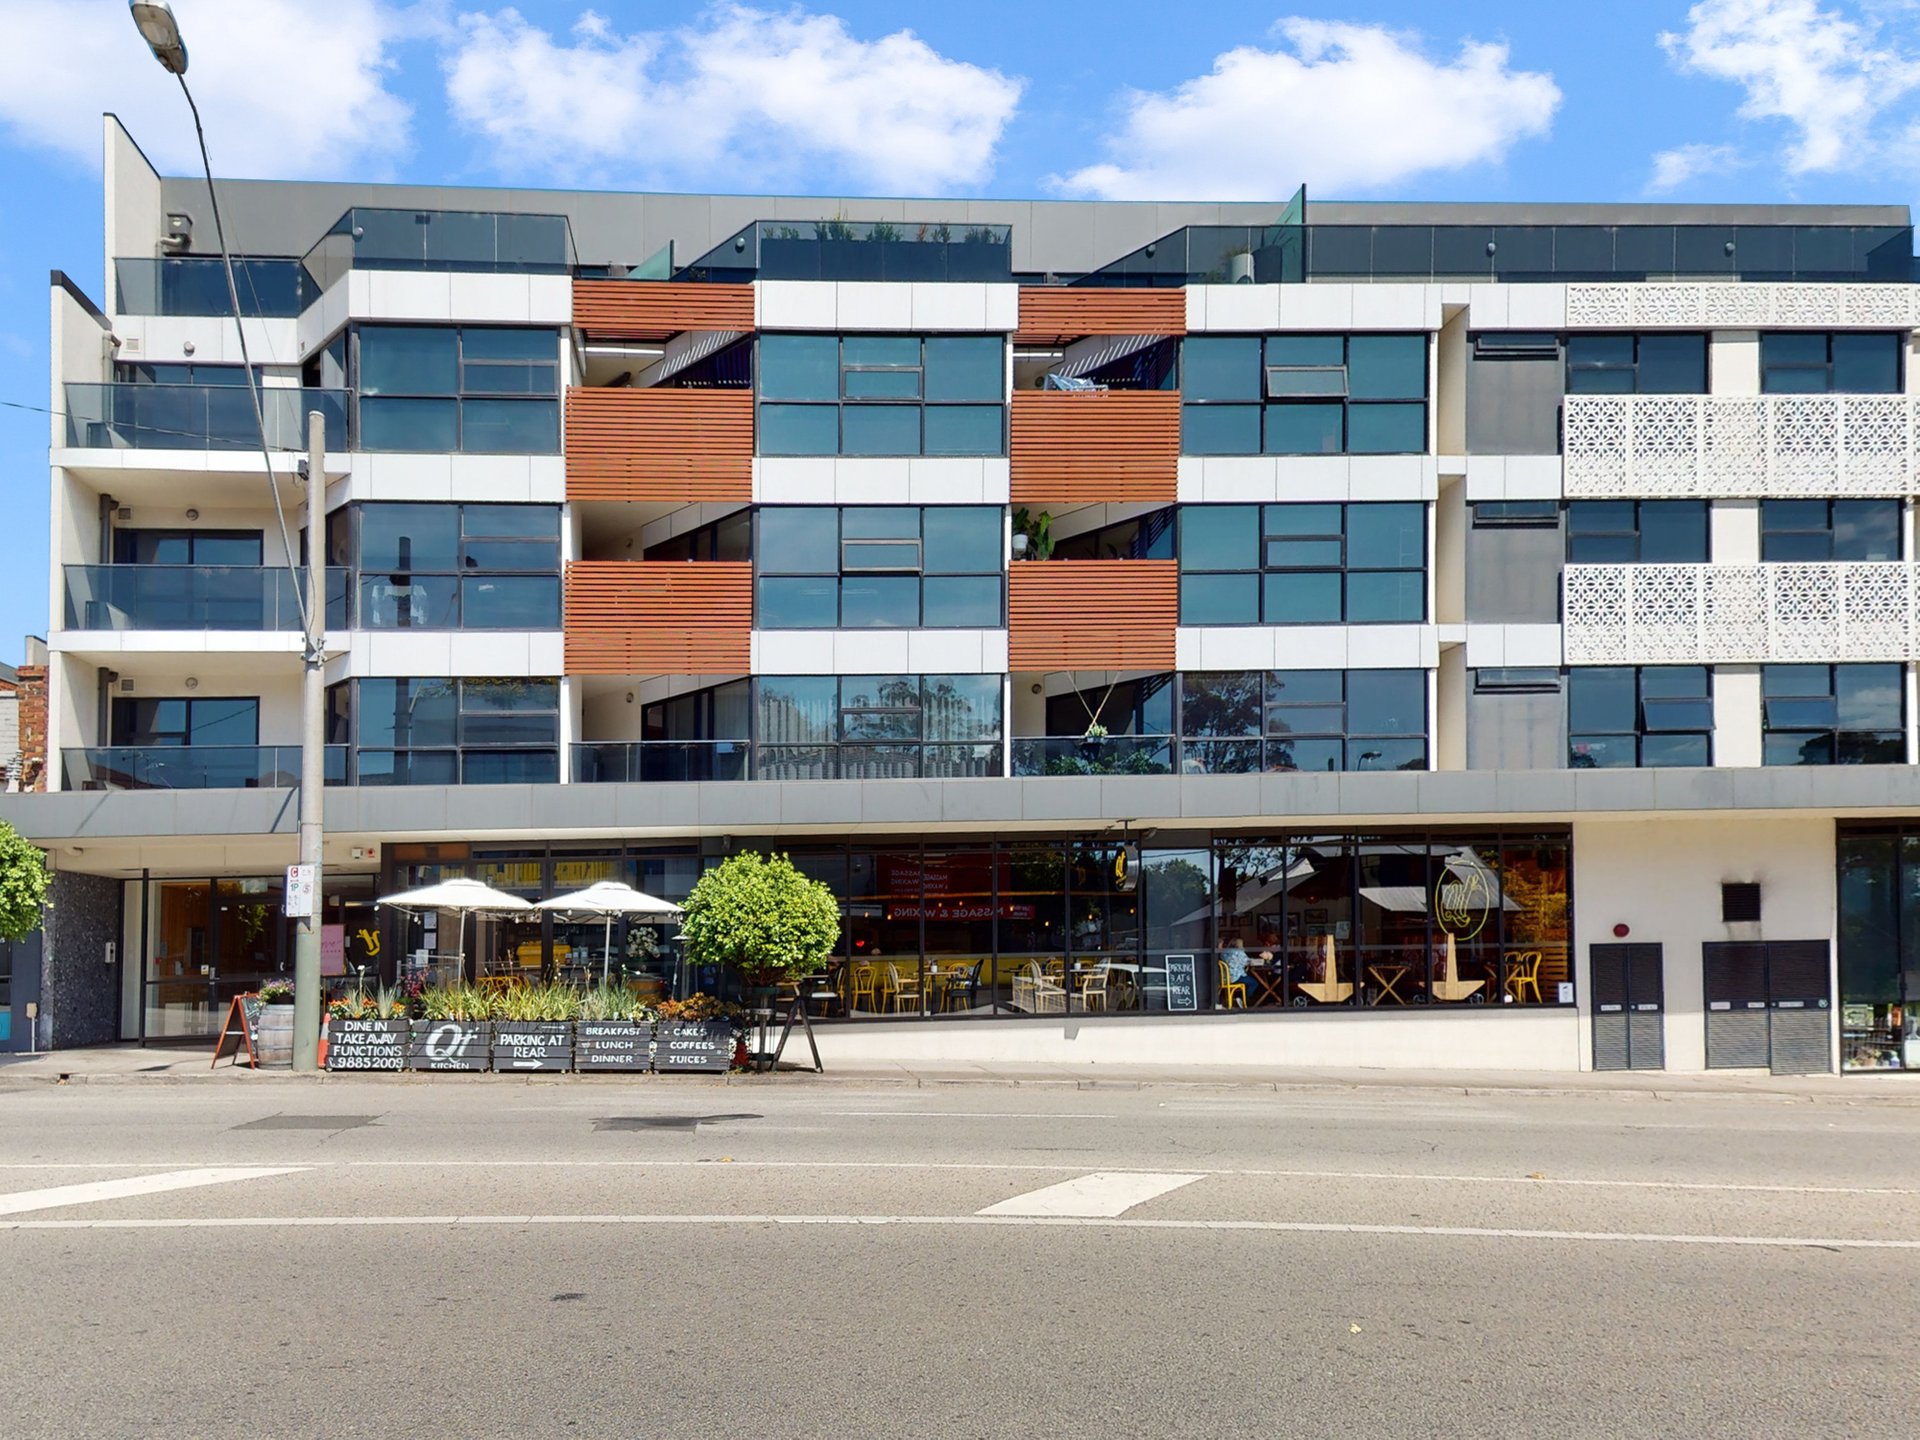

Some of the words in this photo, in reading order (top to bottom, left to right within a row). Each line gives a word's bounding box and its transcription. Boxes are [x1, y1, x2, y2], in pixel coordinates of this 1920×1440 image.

[1176, 974, 1186, 983] AT
[1172, 986, 1190, 995] REAR
[344, 1021, 372, 1031] DINE
[374, 1021, 388, 1031] IN
[585, 1027, 641, 1036] BREAKFAST
[673, 1028, 708, 1036] CAKES
[335, 1033, 365, 1044] TAKE
[366, 1033, 397, 1044] AWAY
[500, 1034, 545, 1045] PARKING
[548, 1034, 565, 1046] AT
[595, 1041, 633, 1049] LUNCH
[670, 1041, 715, 1050] COFFEES
[333, 1045, 402, 1056] FUNCTIONS
[513, 1046, 549, 1058] REAR
[591, 1055, 633, 1063] DINNER
[669, 1055, 707, 1064] JUICES
